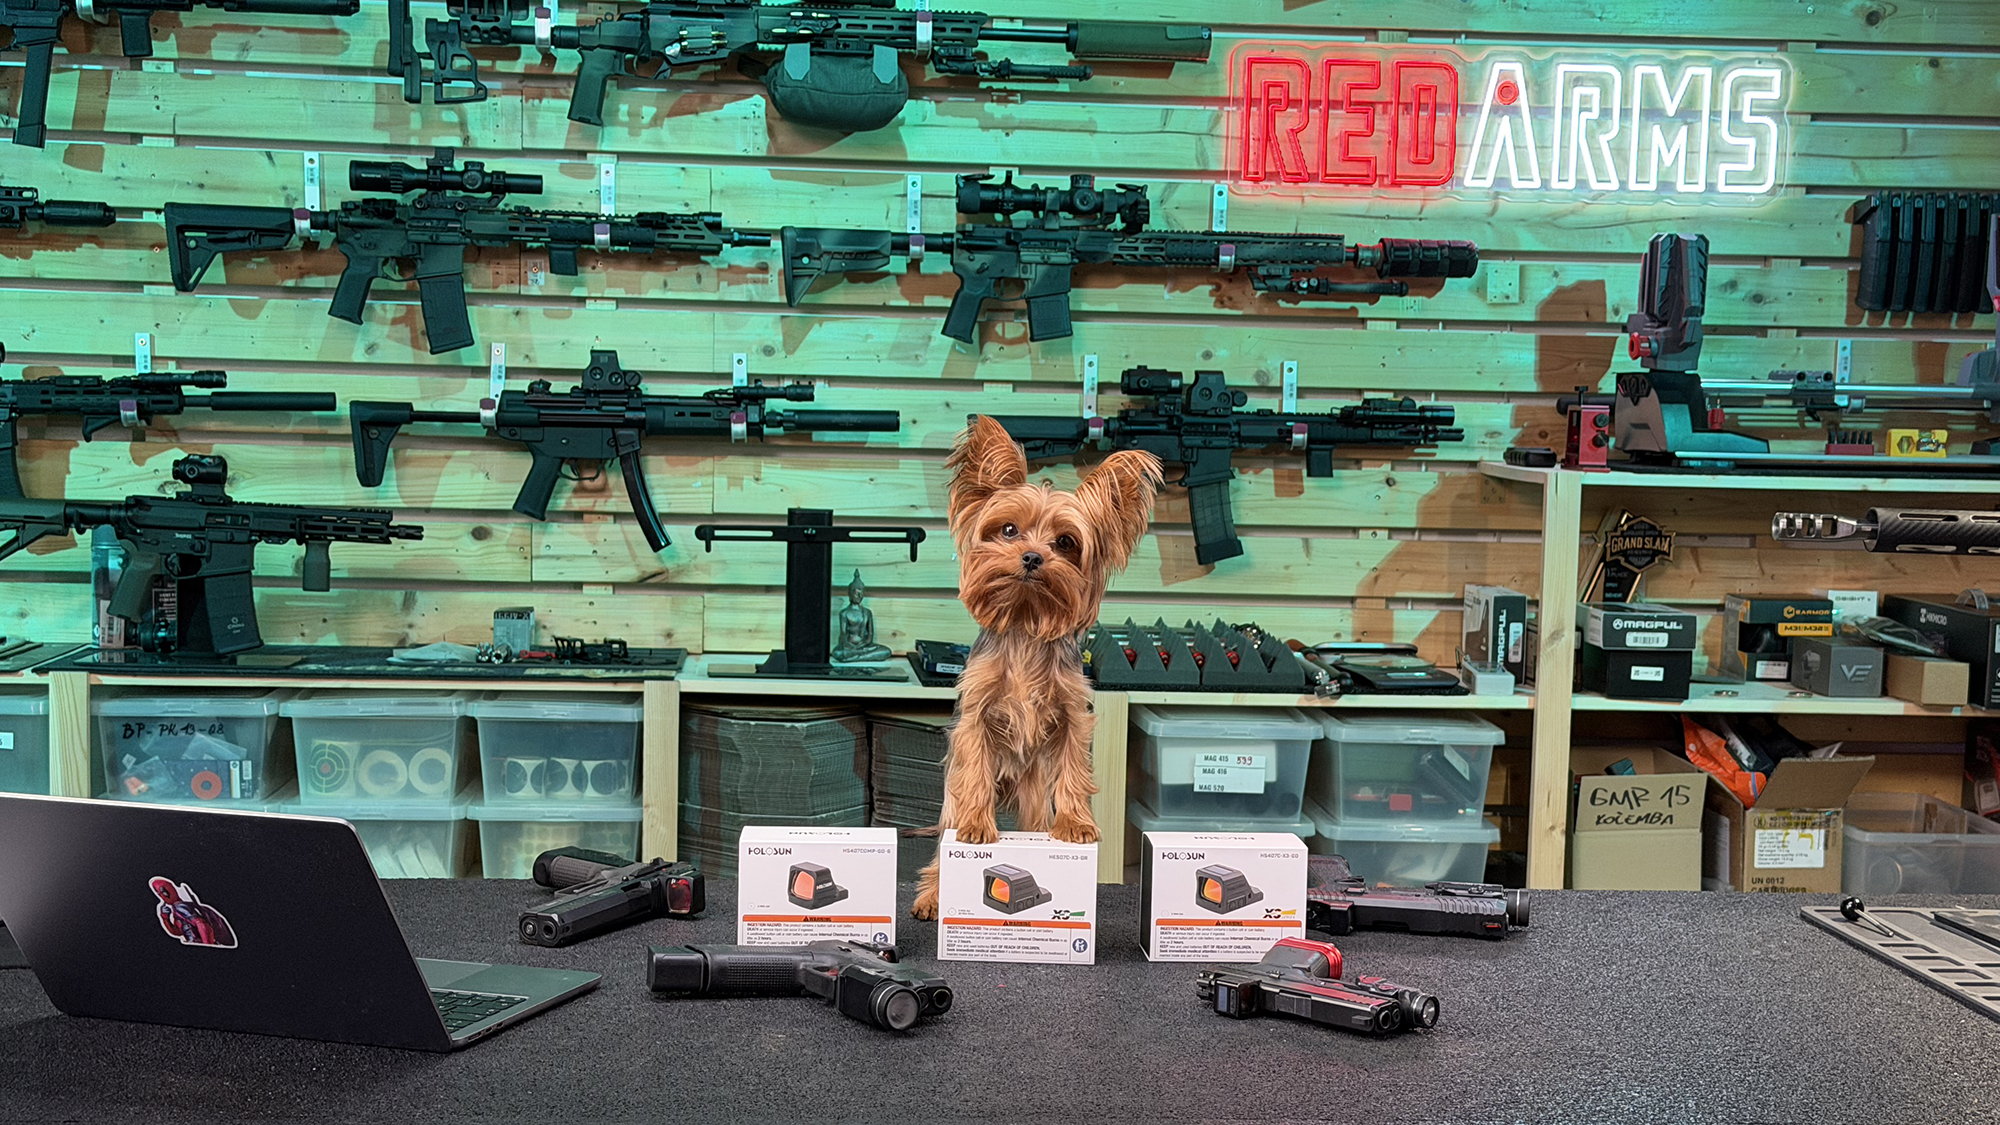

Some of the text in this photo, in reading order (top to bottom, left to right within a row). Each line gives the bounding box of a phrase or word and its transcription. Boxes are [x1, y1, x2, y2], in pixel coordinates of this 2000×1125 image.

[1612, 537, 1643, 553] GRAND
[1644, 537, 1670, 553] SLAM
[1624, 620, 1683, 629] MAGPUL
[1497, 609, 1507, 667] MAGPUL
[1590, 785, 1691, 810] GMR 15
[748, 847, 792, 856] HOLOSUN
[949, 850, 992, 859] HOLOSUN
[1162, 852, 1205, 860] HOLOSUN
